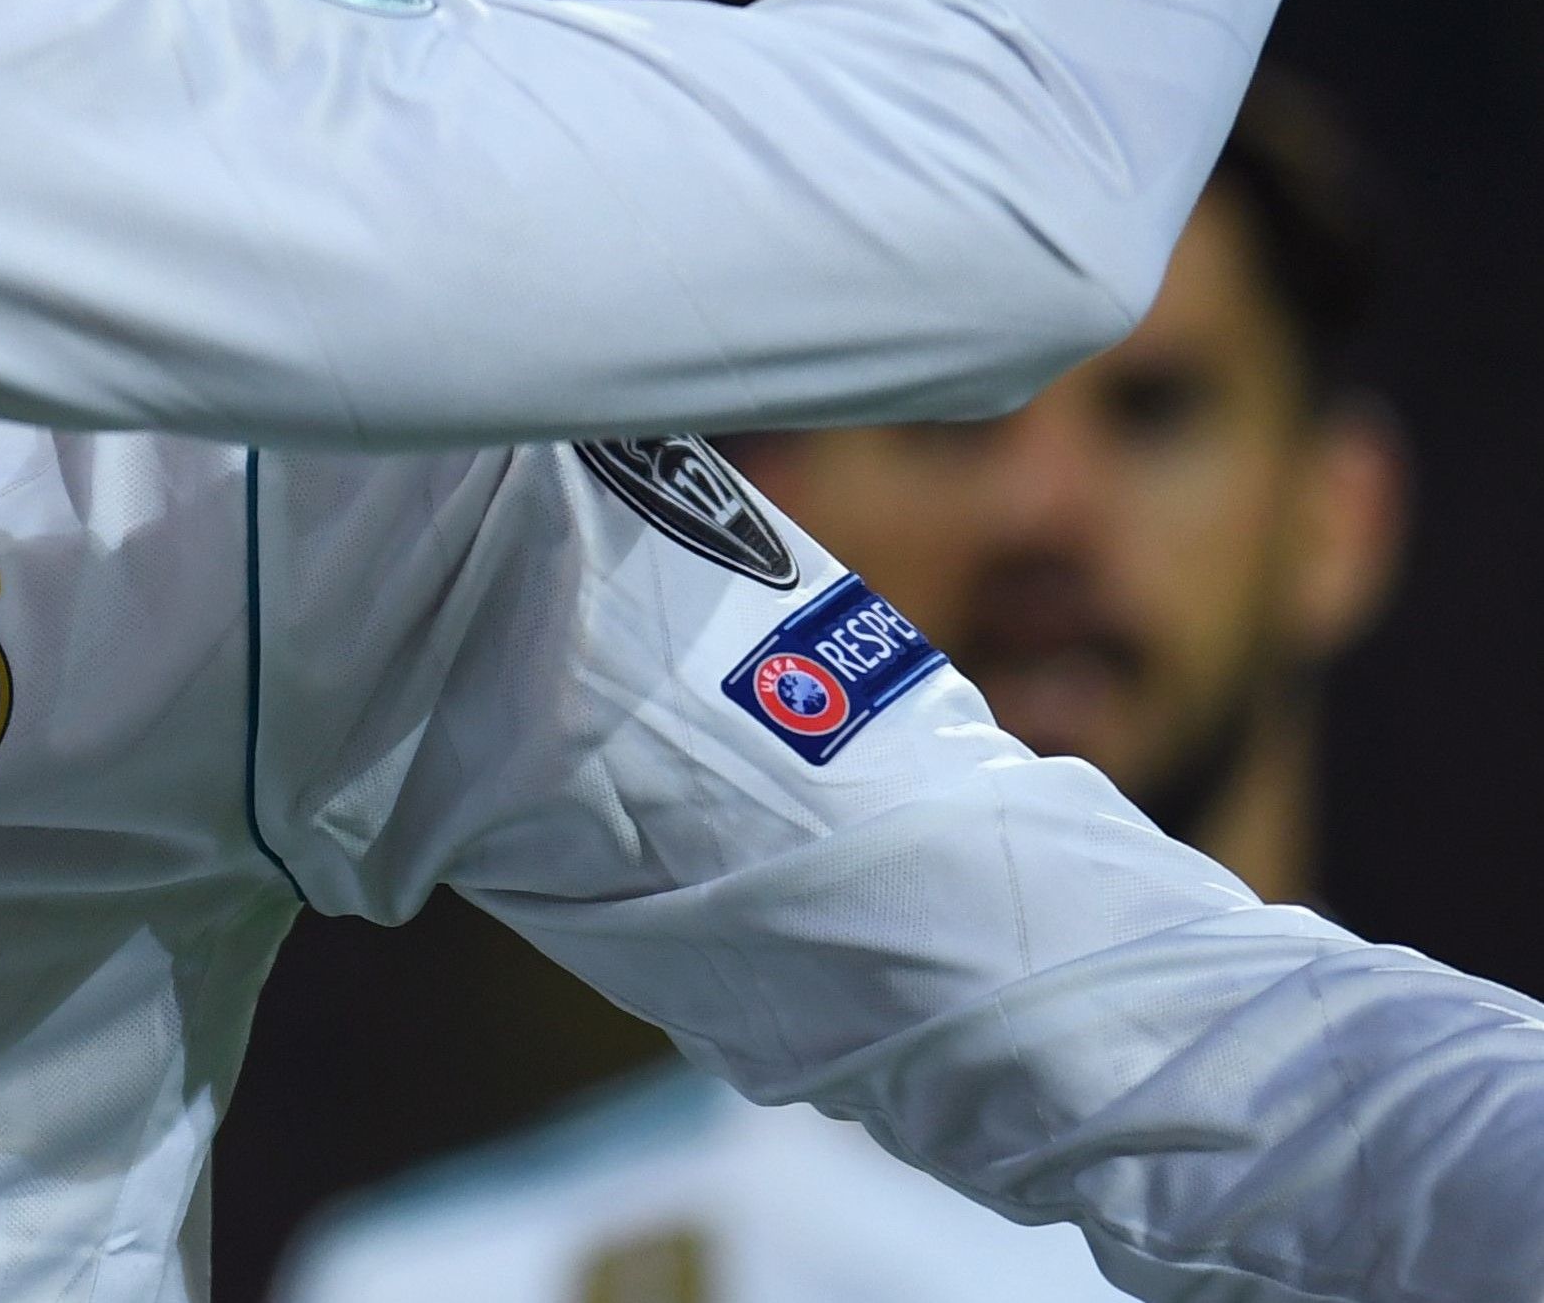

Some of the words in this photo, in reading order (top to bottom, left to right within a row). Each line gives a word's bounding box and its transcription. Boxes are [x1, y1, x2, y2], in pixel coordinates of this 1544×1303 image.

[674, 458, 742, 526] 12
[760, 658, 799, 693] UEFA
[815, 601, 921, 682] RESPE
